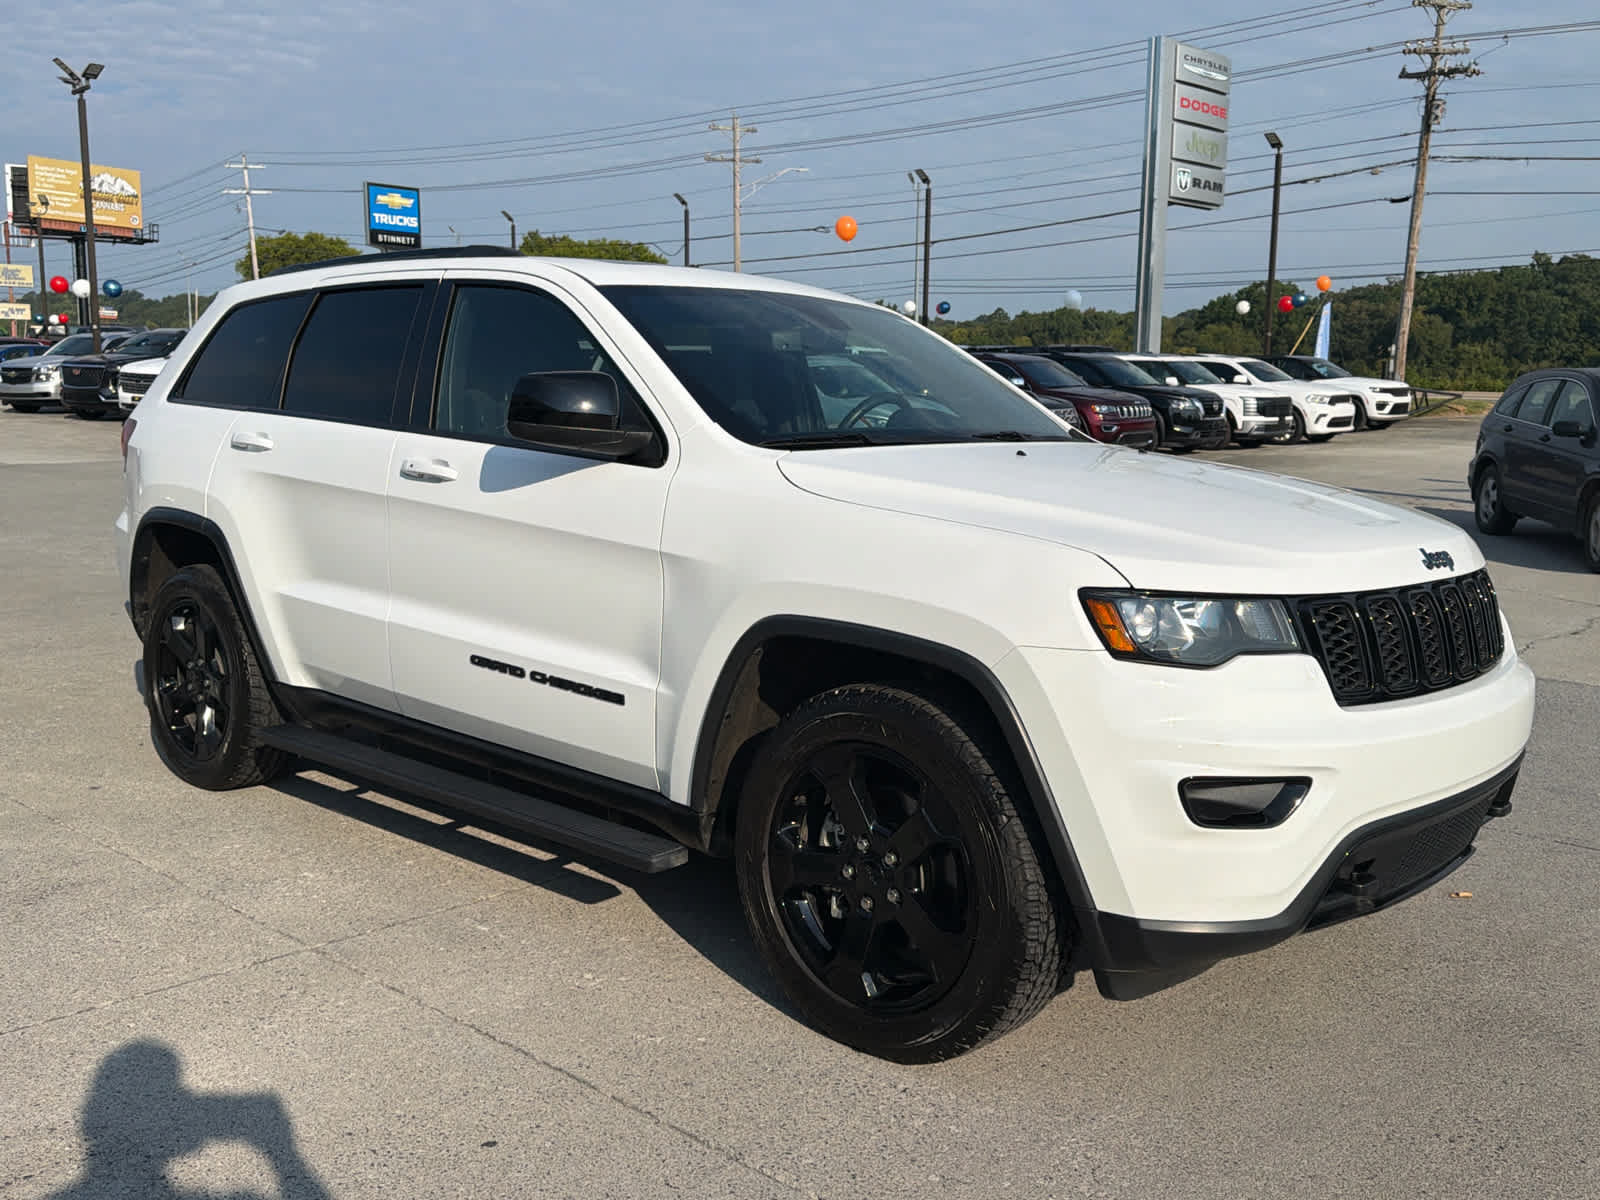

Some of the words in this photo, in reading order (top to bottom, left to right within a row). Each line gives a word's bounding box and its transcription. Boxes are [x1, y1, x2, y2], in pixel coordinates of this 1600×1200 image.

[1184, 54, 1229, 73] CHRYSLER
[1180, 97, 1227, 120] DODGE
[1186, 131, 1220, 161] Jeep
[1191, 178, 1223, 194] RAM
[373, 213, 418, 227] TRUCKS
[378, 234, 415, 245] STINNETT
[1418, 547, 1455, 572] Jeep
[470, 654, 526, 679] GRAND
[530, 670, 625, 706] CHEROKEE
